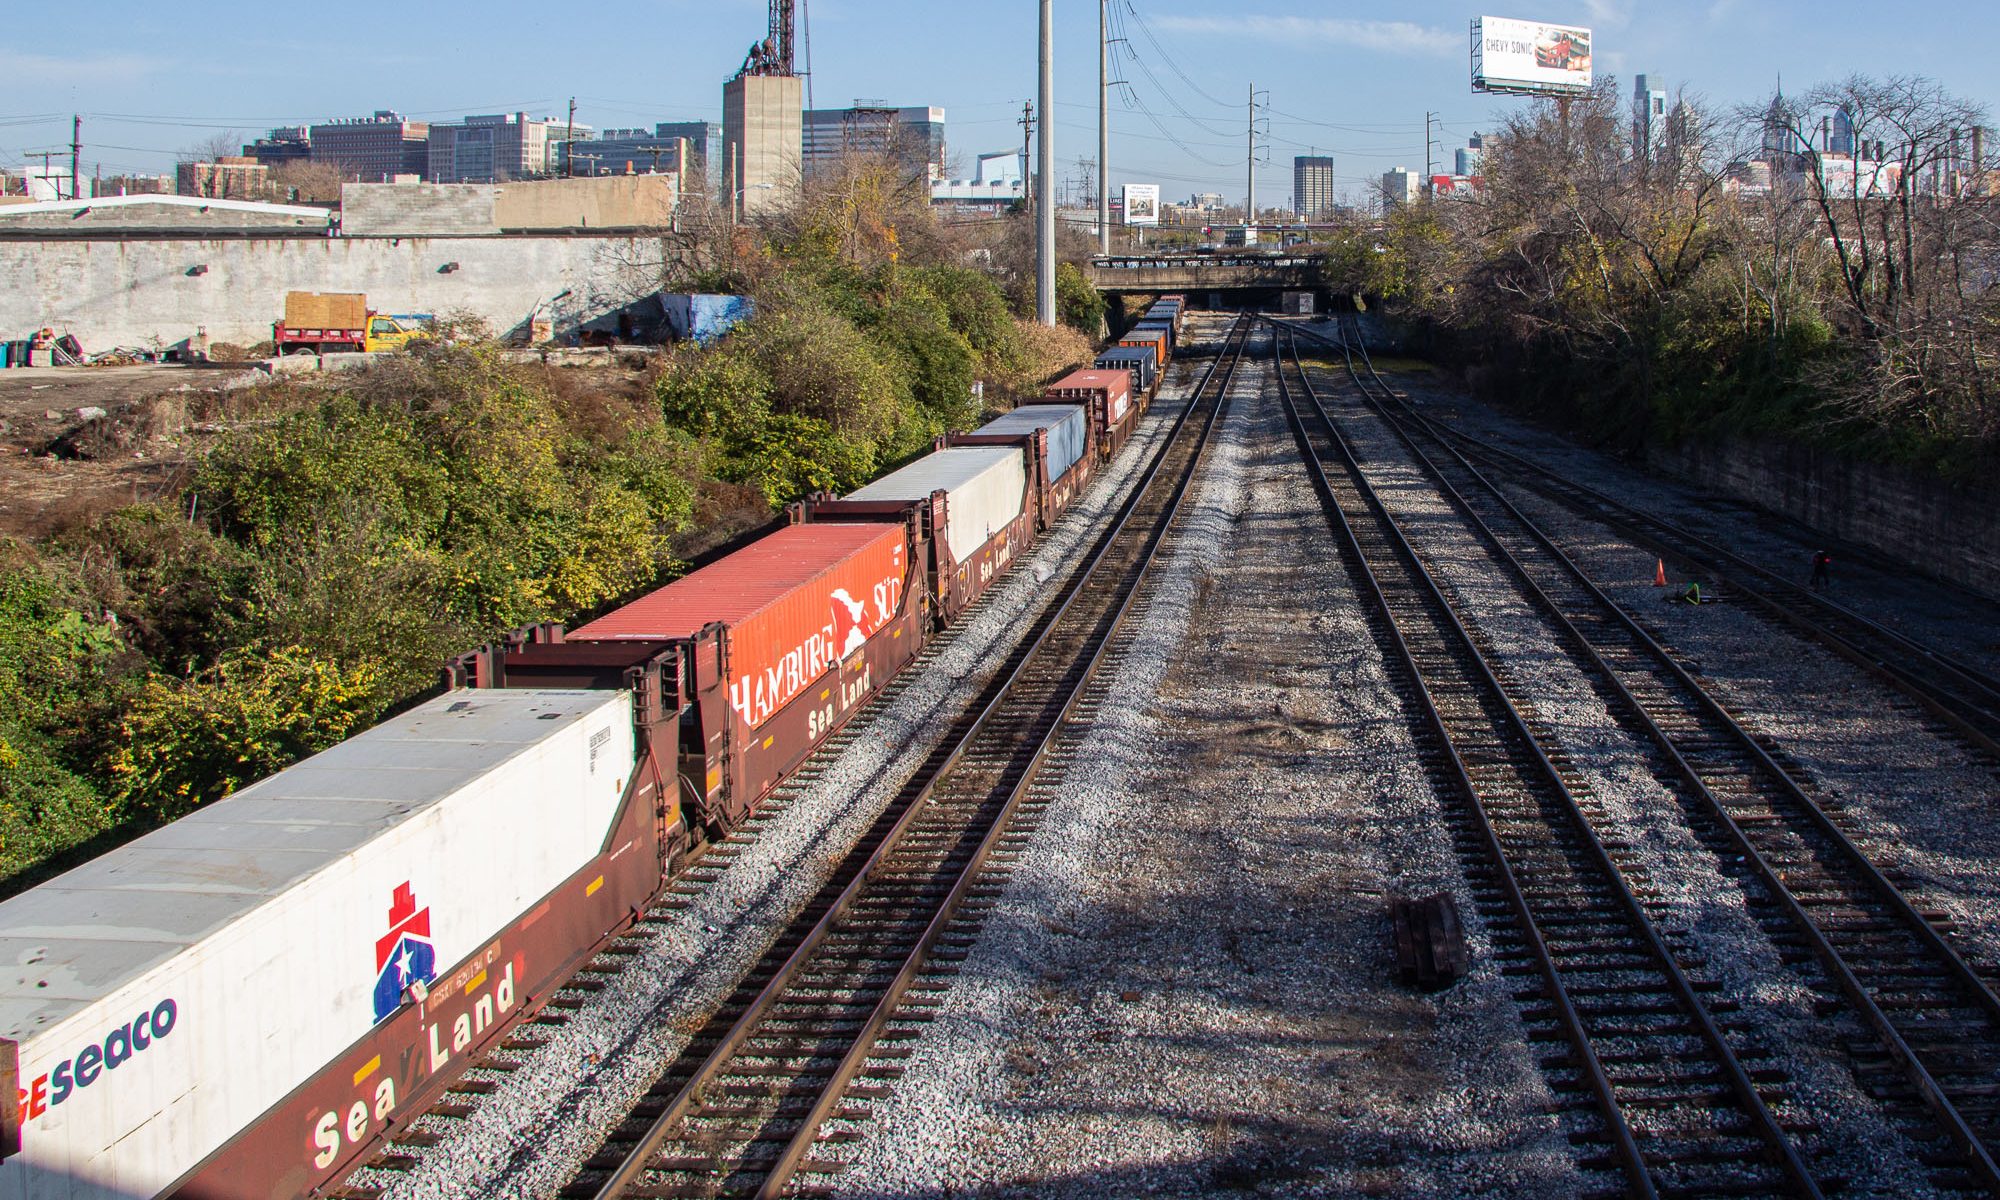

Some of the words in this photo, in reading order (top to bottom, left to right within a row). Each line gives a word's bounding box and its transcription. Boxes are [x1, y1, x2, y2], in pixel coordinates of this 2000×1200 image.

[1486, 38, 1509, 53] CHEVY
[1511, 41, 1533, 55] SONIC
[980, 561, 993, 583] Sea
[995, 539, 1011, 570] Land
[730, 622, 834, 727] HAMBURG
[808, 703, 833, 740] Sea
[841, 663, 870, 712] Land
[313, 1075, 395, 1169] Sea
[429, 962, 515, 1074] Land
